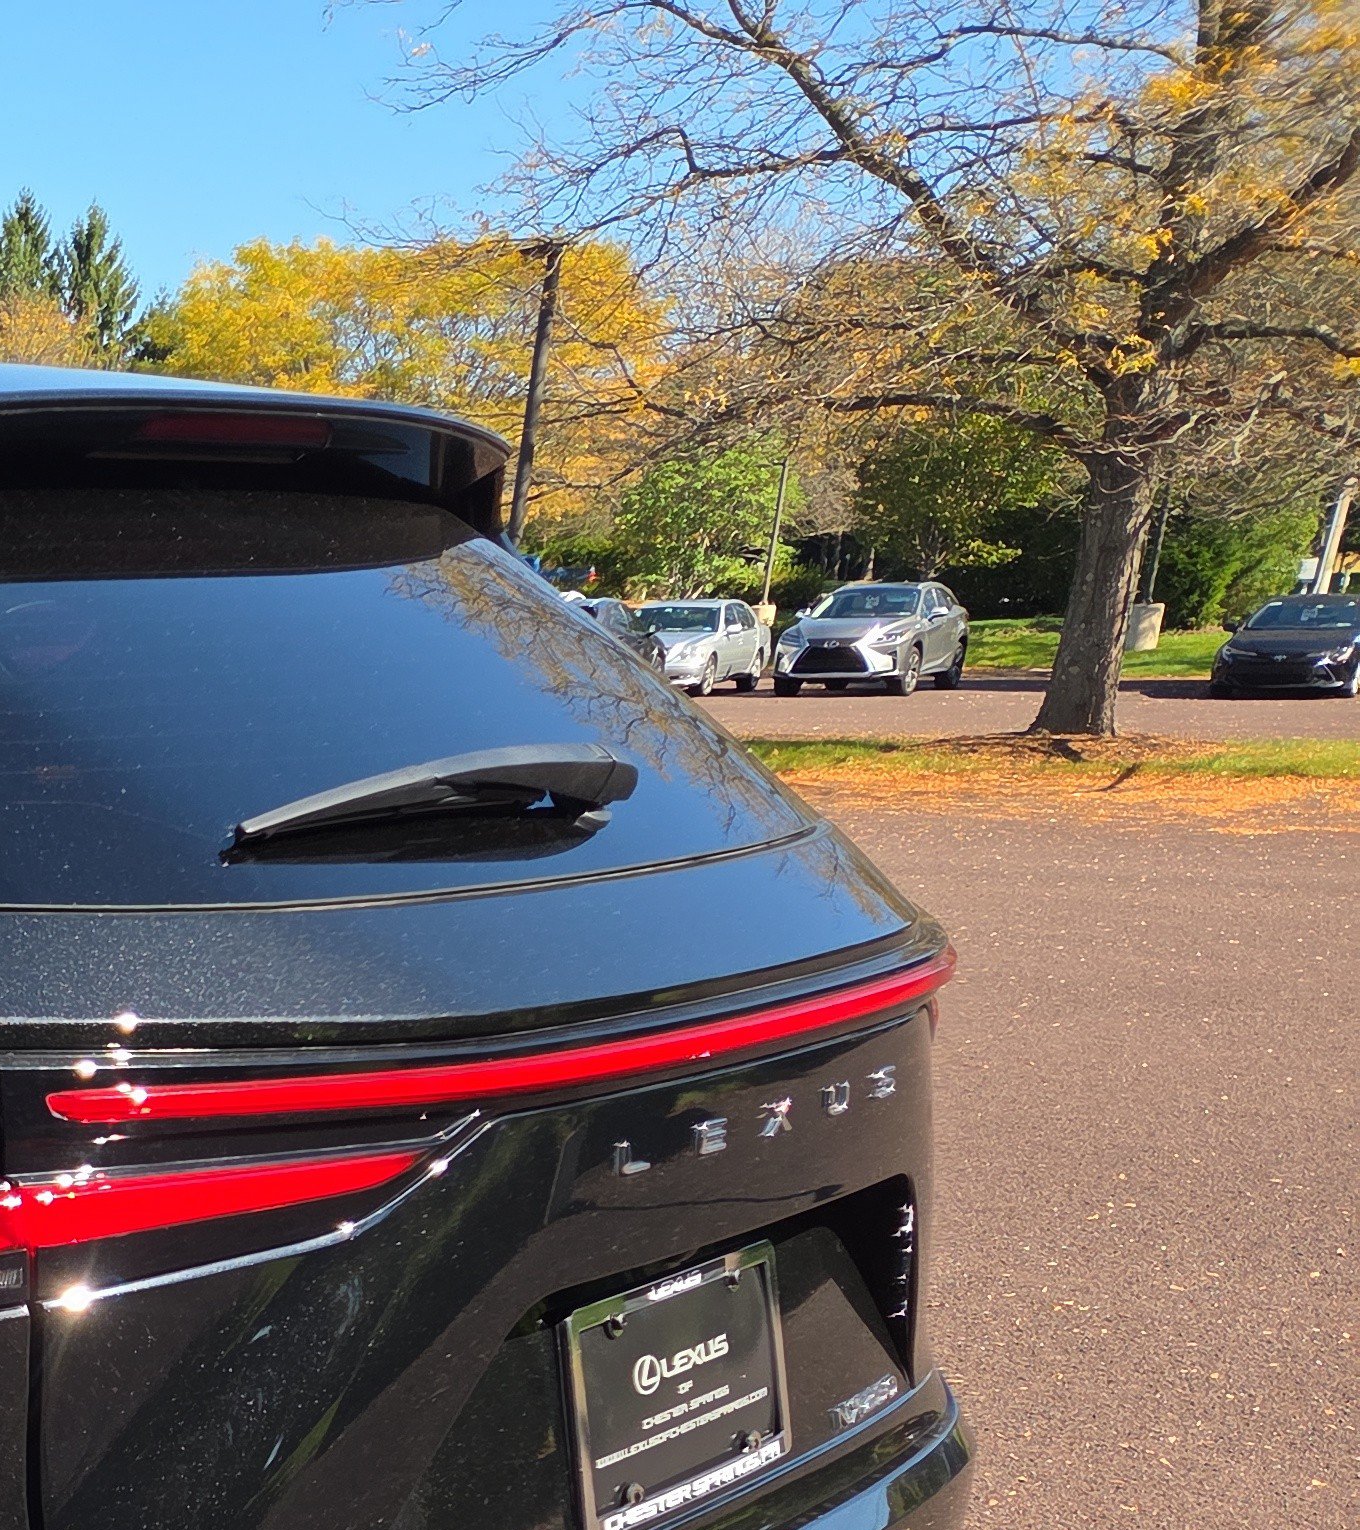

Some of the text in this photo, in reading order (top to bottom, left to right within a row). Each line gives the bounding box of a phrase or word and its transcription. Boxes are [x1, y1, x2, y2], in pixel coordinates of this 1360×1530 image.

[613, 1065, 897, 1176] LEXUS
[647, 1270, 702, 1301] LEXUS
[660, 1333, 729, 1378] LEXUS
[641, 1384, 730, 1430] CHESTER SPRINGS
[677, 1380, 694, 1395] OF
